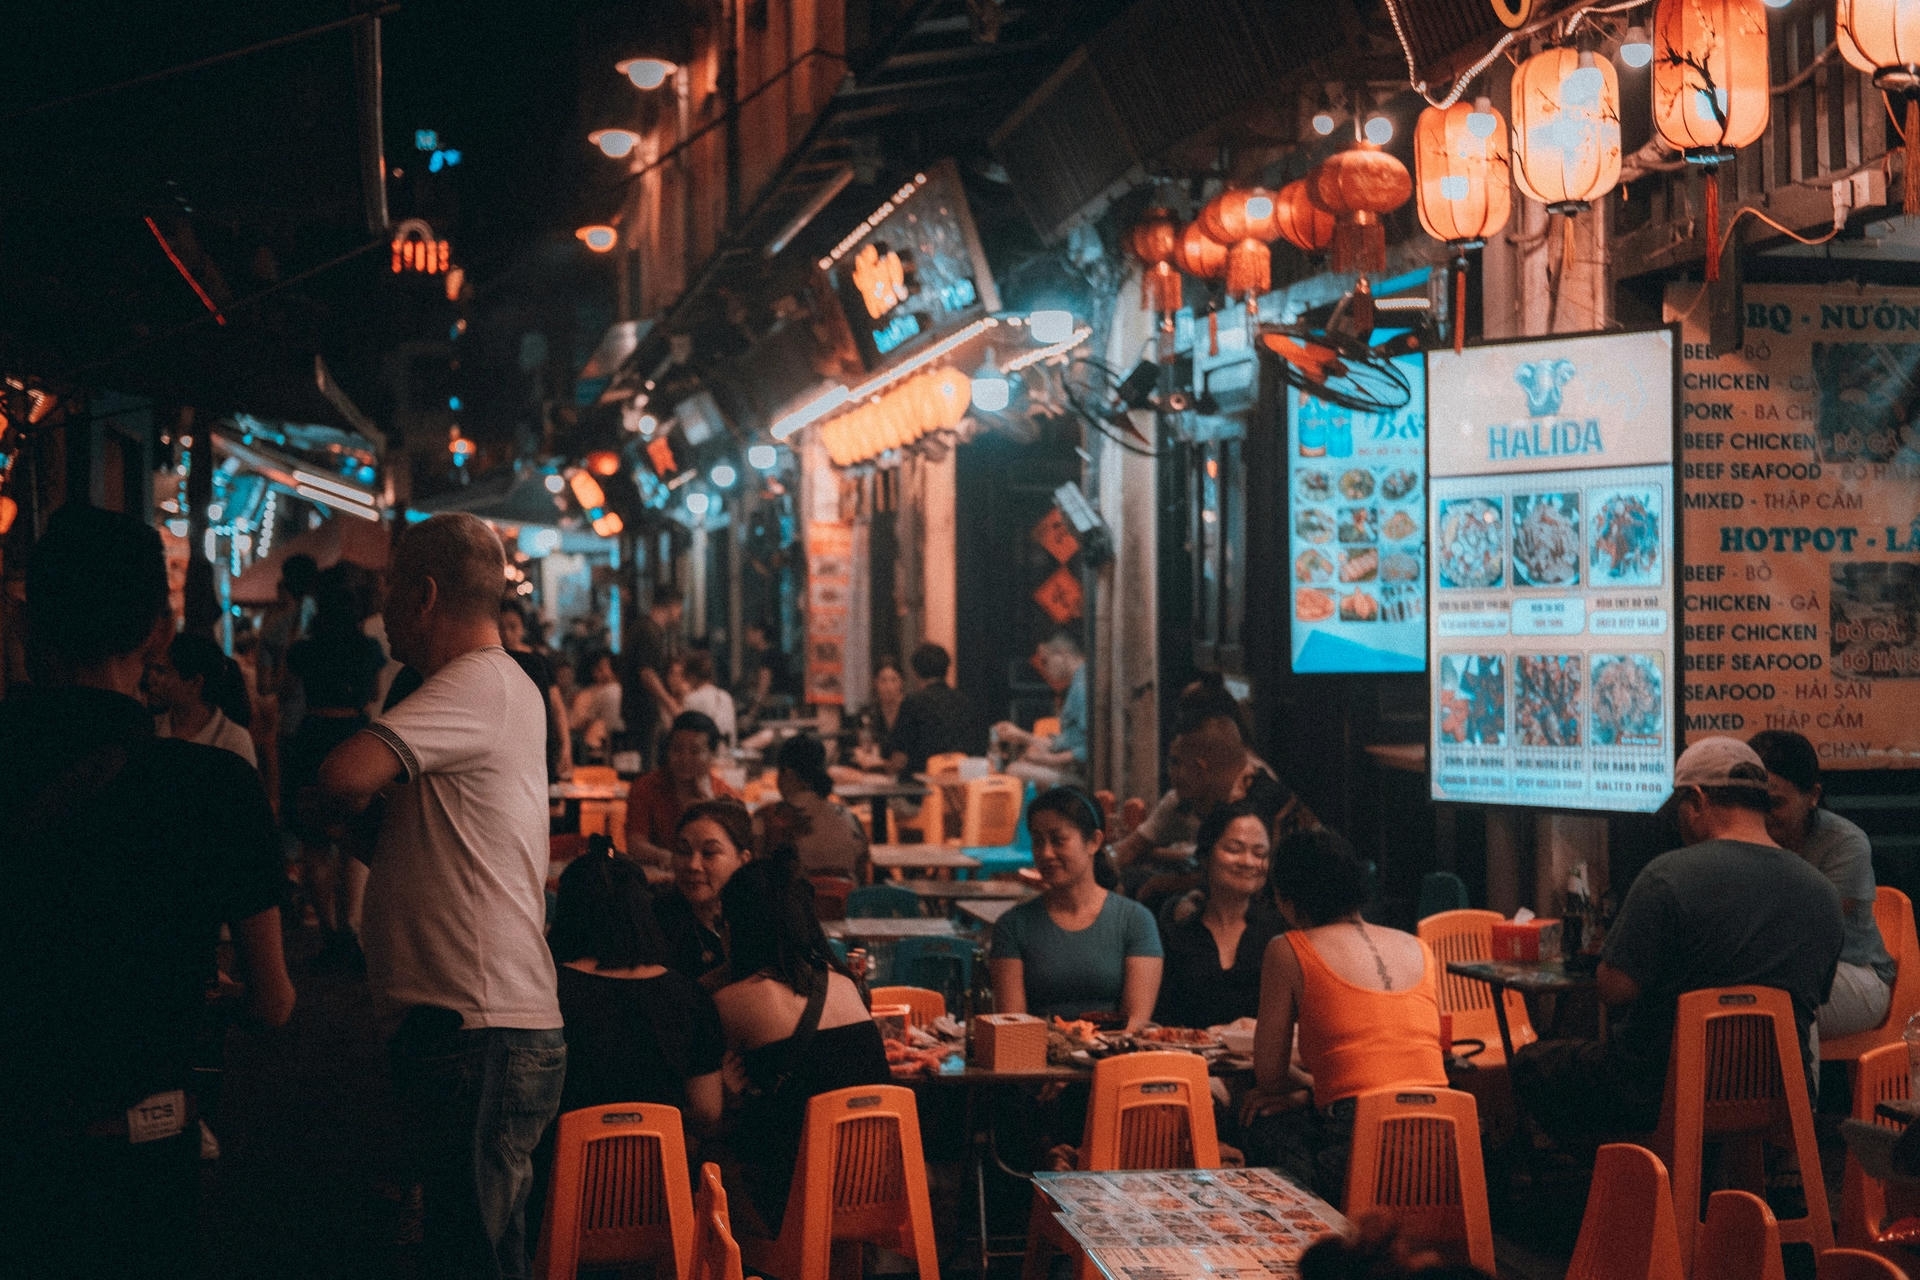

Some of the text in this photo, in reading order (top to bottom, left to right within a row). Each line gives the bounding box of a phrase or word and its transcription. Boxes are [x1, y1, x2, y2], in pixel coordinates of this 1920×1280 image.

[1745, 303, 1793, 335] BQ
[1684, 373, 1770, 390] CHICKEN
[1684, 403, 1734, 420] PORK
[1755, 404, 1780, 420] BA
[1487, 418, 1605, 460] HALIDA
[1684, 433, 1725, 449] BEEF
[1730, 433, 1816, 450] CHICKEN
[1684, 463, 1725, 480] BEEF
[1731, 463, 1822, 480] SEAFOOD
[1684, 493, 1744, 509] MIXED
[1720, 526, 1858, 552] HOTPOT
[1684, 560, 1772, 582] BEEF BÒ
[1684, 590, 1821, 611] CHICKEN GÀ
[1684, 624, 1725, 641] BEEF
[1731, 624, 1818, 641] CHICKEN
[1684, 654, 1725, 671] BEEF
[1731, 654, 1823, 671] SEAFOOD
[1684, 684, 1776, 700] SEAFOOD
[1684, 713, 1745, 730] MIXED
